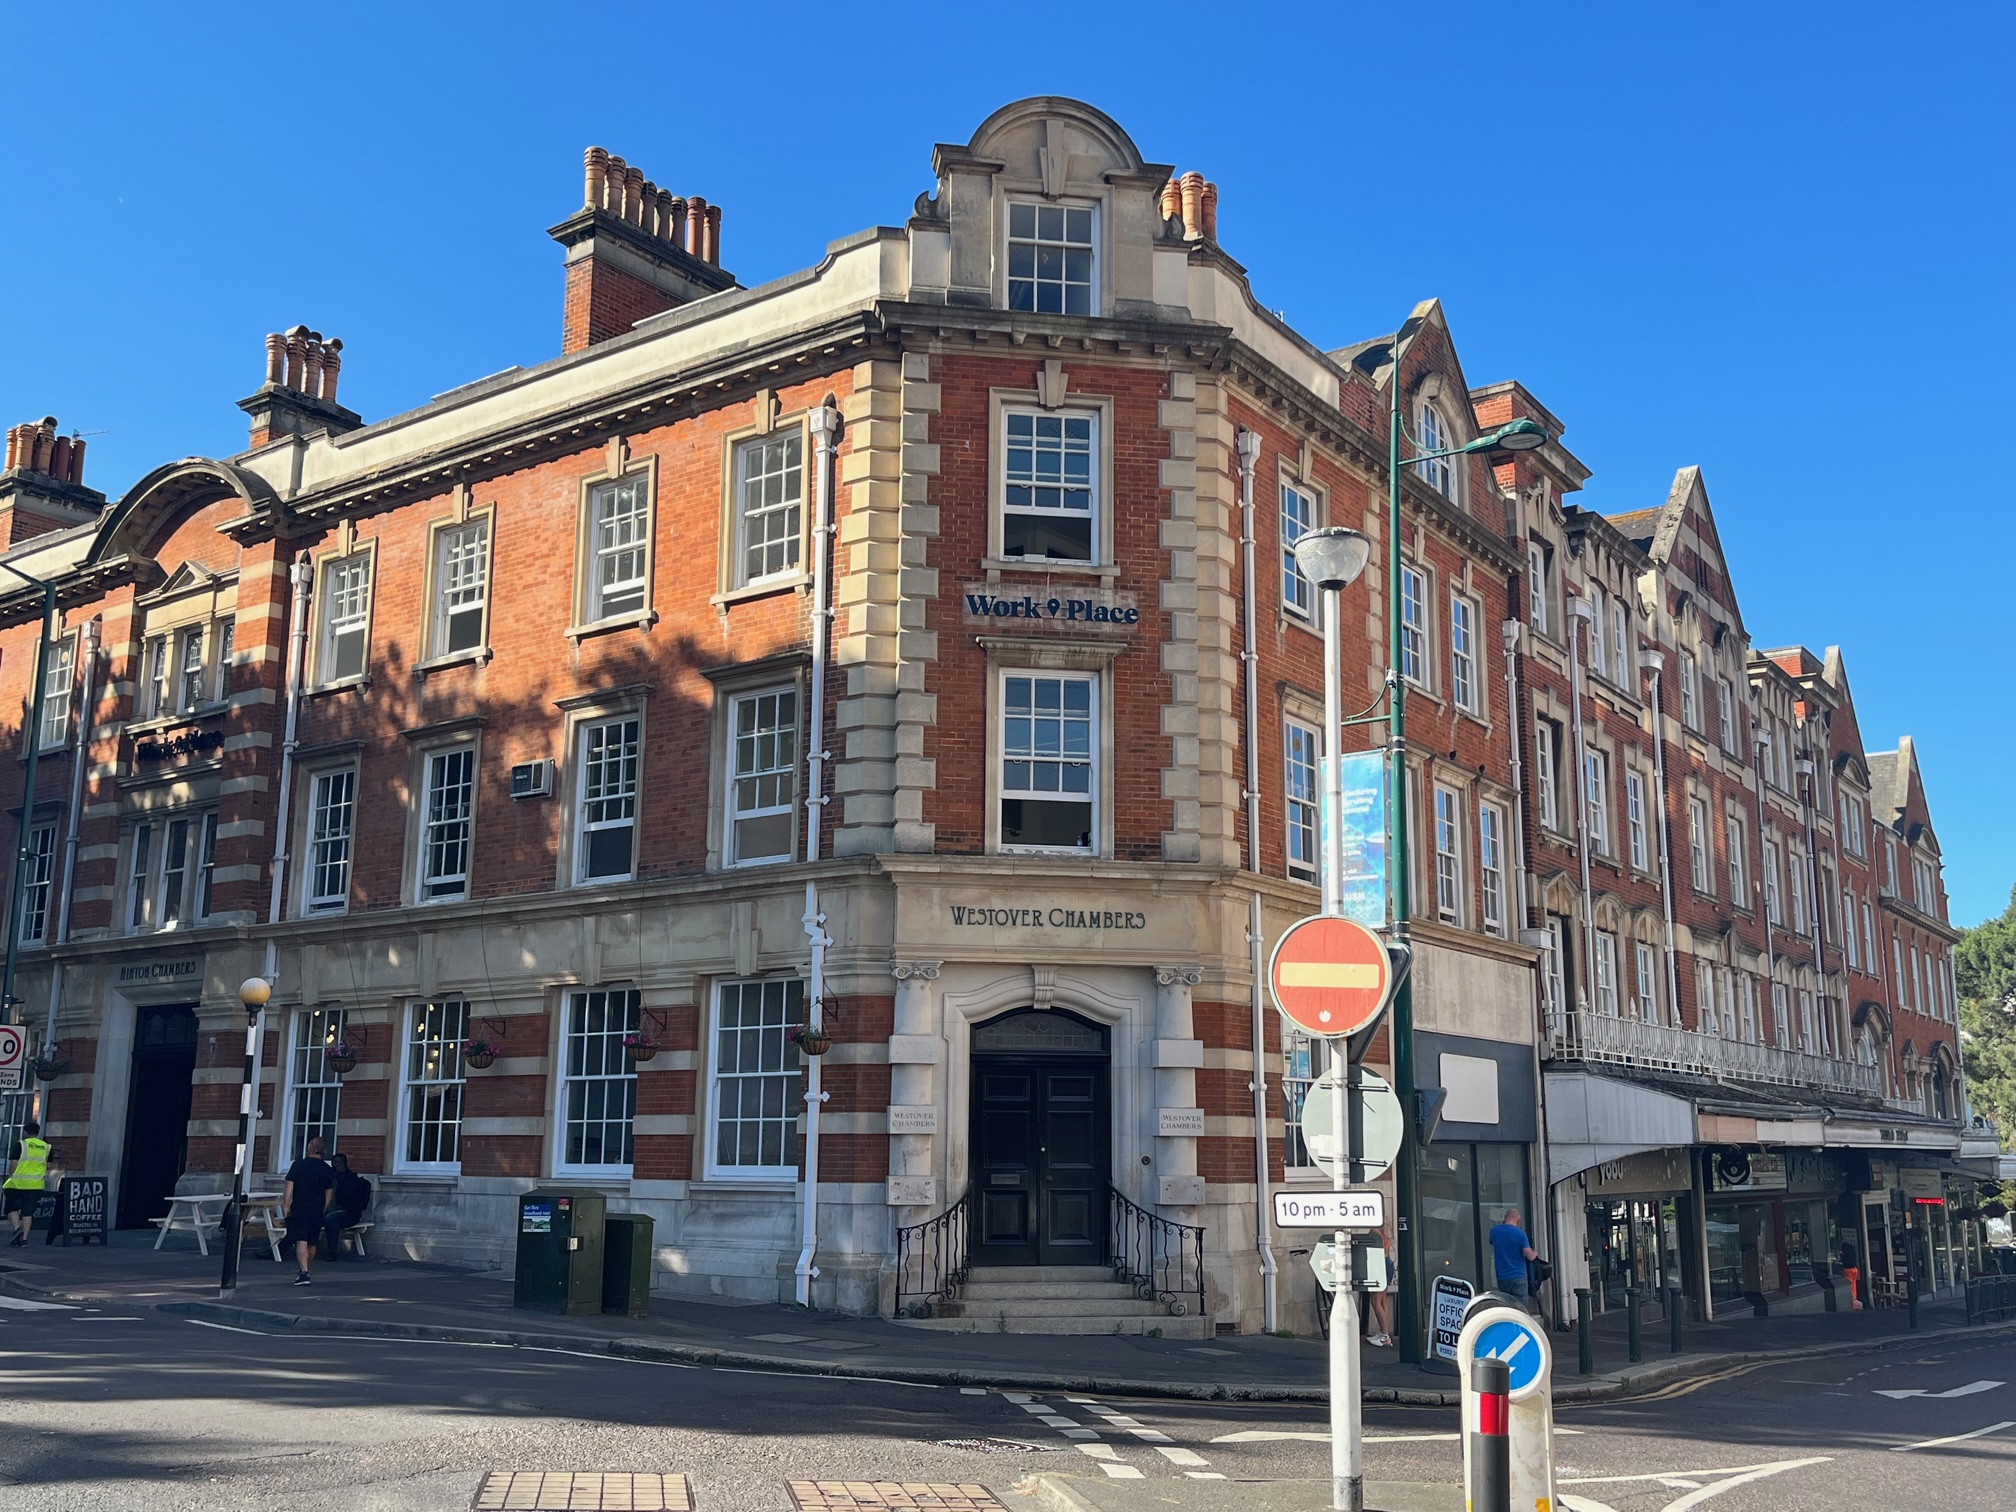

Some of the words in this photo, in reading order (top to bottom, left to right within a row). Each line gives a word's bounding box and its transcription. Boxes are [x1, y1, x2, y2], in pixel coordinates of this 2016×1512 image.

[966, 594, 1042, 618] Work
[1067, 600, 1139, 624] Place
[1344, 892, 1365, 901] USH
[950, 906, 1043, 926] WESTOVER
[1049, 908, 1146, 929] CHAMBERS
[120, 966, 150, 980] HINTON
[152, 961, 196, 977] CHAMBERS
[0, 1039, 15, 1054] 0
[70, 1181, 103, 1200] BAD
[69, 1195, 103, 1213] HAND
[1282, 1202, 1299, 1216] 10
[1304, 1205, 1325, 1219] pm
[1339, 1202, 1348, 1216] 5
[1353, 1205, 1375, 1216] am
[1440, 1283, 1452, 1292] Work
[1457, 1287, 1470, 1296] Place
[1444, 1297, 1465, 1305] LUXURY
[1439, 1303, 1464, 1318] OFFIC
[1440, 1316, 1461, 1331] SPAC
[1439, 1331, 1451, 1344] TO
